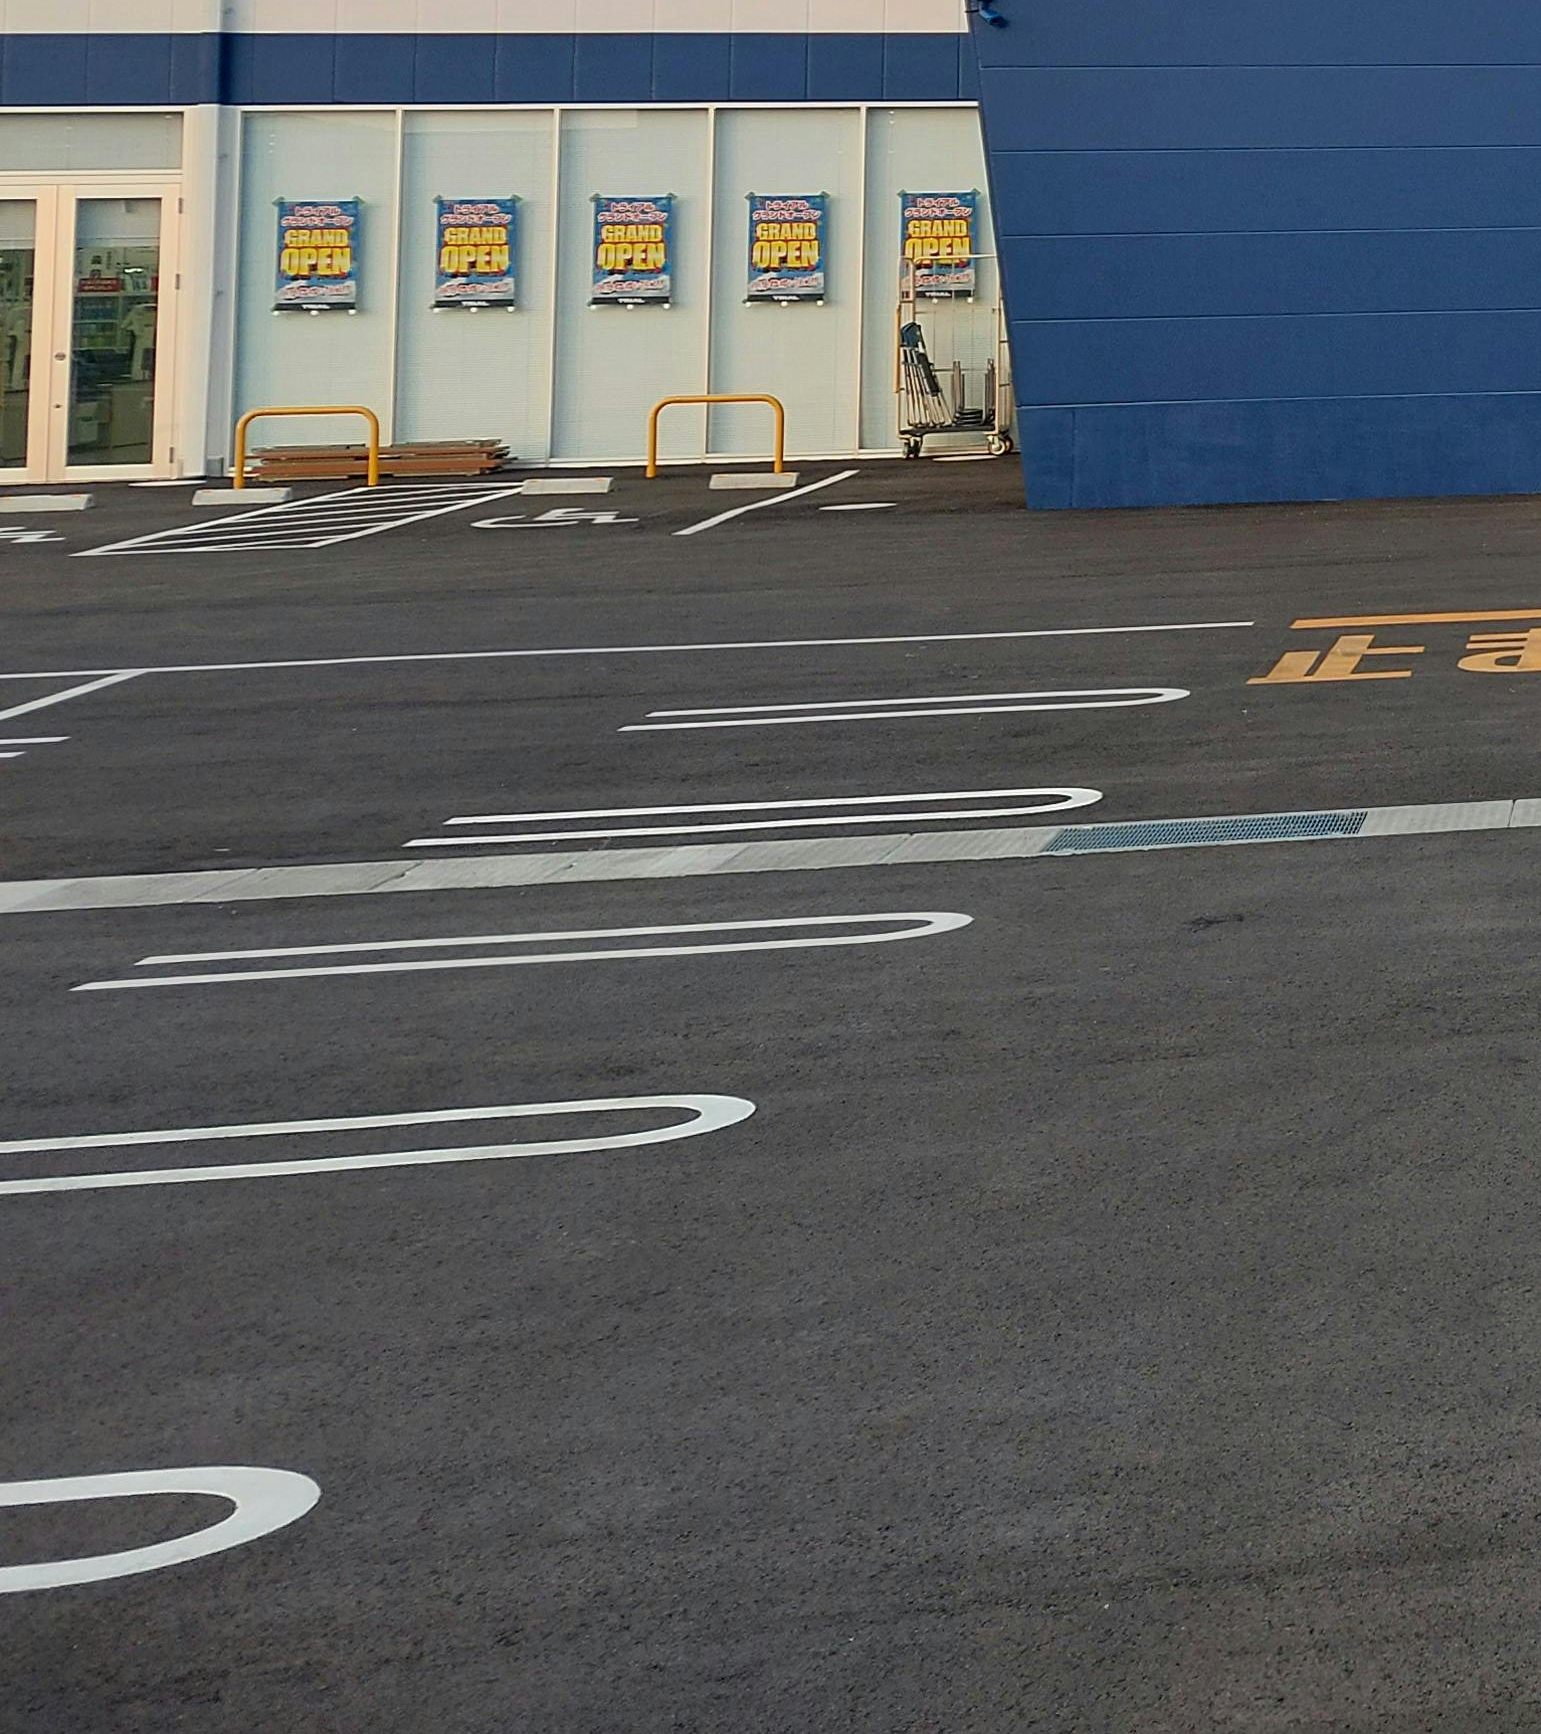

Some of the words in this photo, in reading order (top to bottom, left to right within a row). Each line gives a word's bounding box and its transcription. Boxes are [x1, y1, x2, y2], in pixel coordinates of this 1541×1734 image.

[284, 229, 349, 246] GRAND
[444, 227, 507, 244] GRAND
[601, 225, 662, 242] GRAND
[756, 223, 816, 240] GRAND
[908, 219, 967, 236] GRAND
[281, 247, 351, 275] OPEN
[441, 245, 509, 272] OPEN
[597, 243, 665, 269] OPEN
[752, 241, 818, 267] OPEN
[905, 237, 970, 264] OPEN
